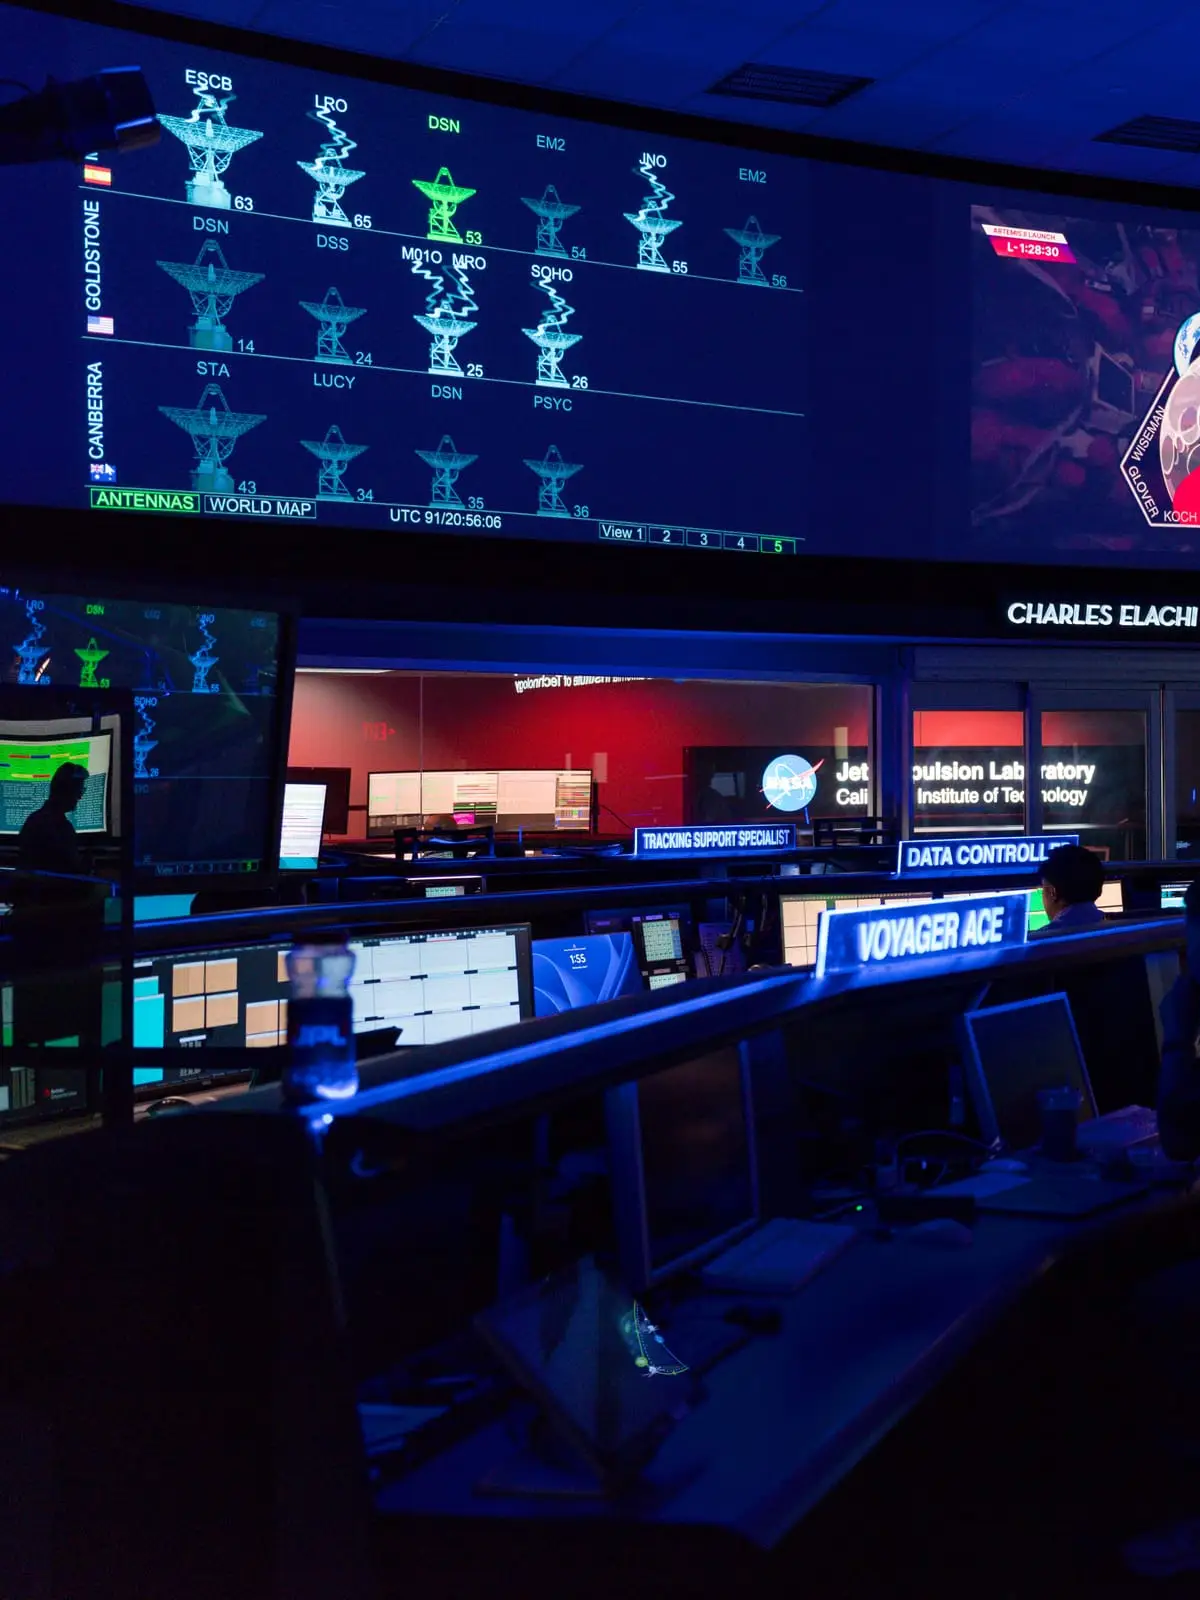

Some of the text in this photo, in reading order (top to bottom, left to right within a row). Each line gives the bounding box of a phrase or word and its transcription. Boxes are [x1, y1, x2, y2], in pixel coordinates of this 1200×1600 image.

[185, 69, 233, 91] ESCB
[314, 94, 348, 112] LRO
[428, 115, 460, 133] DSN
[536, 135, 565, 151] EM2
[639, 152, 667, 168] JNO
[739, 167, 767, 184] EM2
[234, 197, 254, 211] 63
[193, 215, 229, 235] DSN
[353, 214, 372, 229] 65
[316, 233, 349, 251] DSS
[466, 231, 482, 245] 53
[84, 199, 100, 311] GOLDSTONE
[571, 246, 587, 260] 54
[452, 254, 487, 271] MRO
[672, 260, 688, 274] 55
[531, 264, 573, 282] SOHO
[771, 274, 788, 288] 56
[238, 339, 255, 353] 14
[356, 352, 373, 366] 24
[197, 360, 231, 378] STA
[466, 363, 484, 378] 25
[314, 373, 356, 389] LUCY
[572, 375, 588, 389] 26
[431, 385, 463, 400] DSN
[87, 361, 104, 460] CANBERRA
[533, 395, 573, 412] PSYC
[1131, 406, 1166, 462] WISEMAN
[238, 480, 257, 494] 43
[356, 488, 374, 501] 34
[1128, 465, 1160, 519] GLOVER
[96, 492, 195, 510] ANTENNAS
[210, 497, 312, 517] WORLD MAP
[468, 496, 485, 510] 35
[389, 508, 502, 530] UTC 91/20:56:06
[573, 505, 589, 518] 36
[1164, 511, 1197, 522] KOCH
[601, 524, 782, 553] View 1 2 3 4 5
[1007, 601, 1113, 626] CHARLES
[1119, 605, 1198, 628] ELACHI
[836, 761, 869, 782] Jet
[989, 761, 1096, 784] Labratory
[766, 775, 814, 790] NASA
[917, 787, 979, 805] Institute
[983, 787, 999, 803] of
[643, 828, 790, 849] TRACKING SUPPORT SPECIALIST
[907, 842, 1071, 867] DATA CONTROLL
[860, 906, 1004, 962] VOYAGER ACE
[569, 953, 586, 964] 1:55
